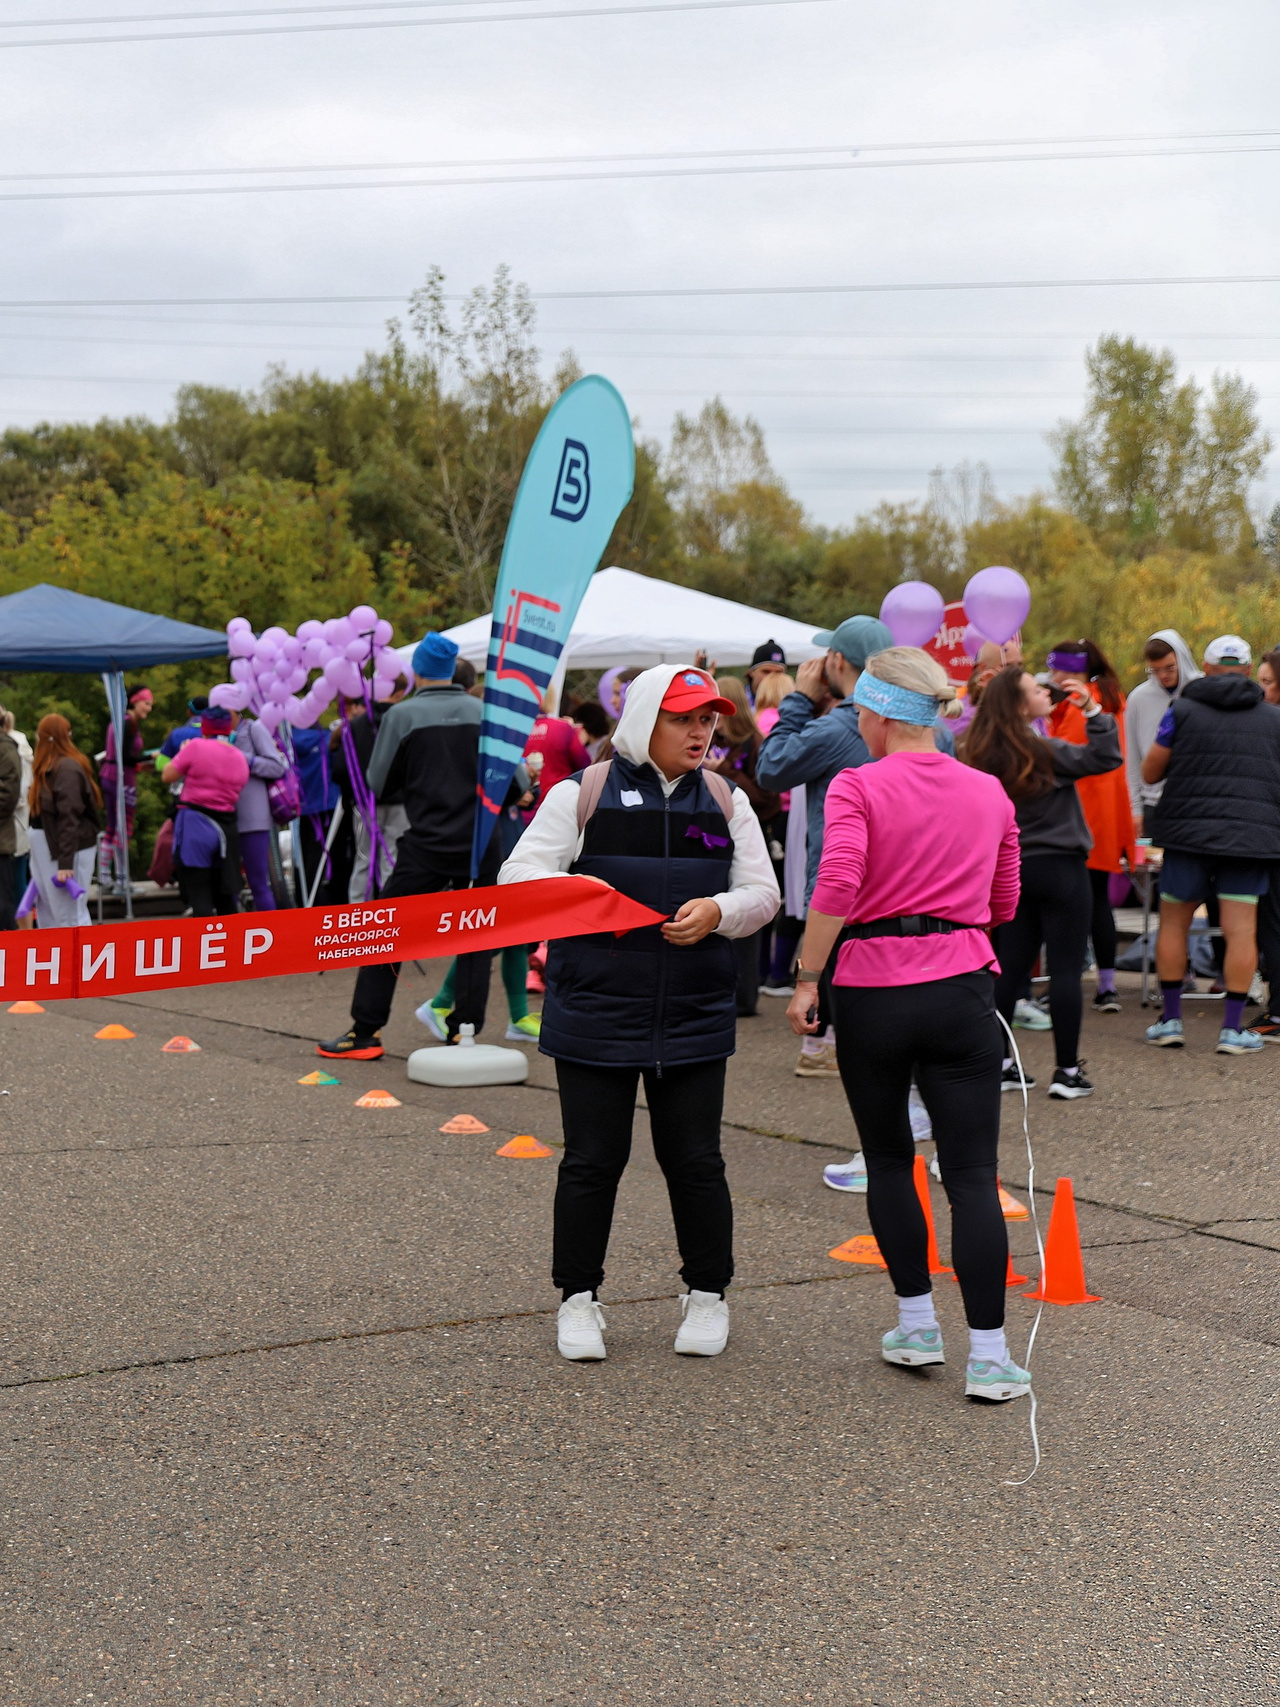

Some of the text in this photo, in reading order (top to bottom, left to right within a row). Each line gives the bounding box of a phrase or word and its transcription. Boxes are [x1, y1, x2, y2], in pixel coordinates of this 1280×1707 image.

[322, 907, 397, 930] 5 ВЁРСТ
[436, 906, 498, 934] 5 КМ
[314, 926, 401, 947] КРАСНОЯРСК
[318, 942, 395, 961] НАБЕРЕЖНАЯ
